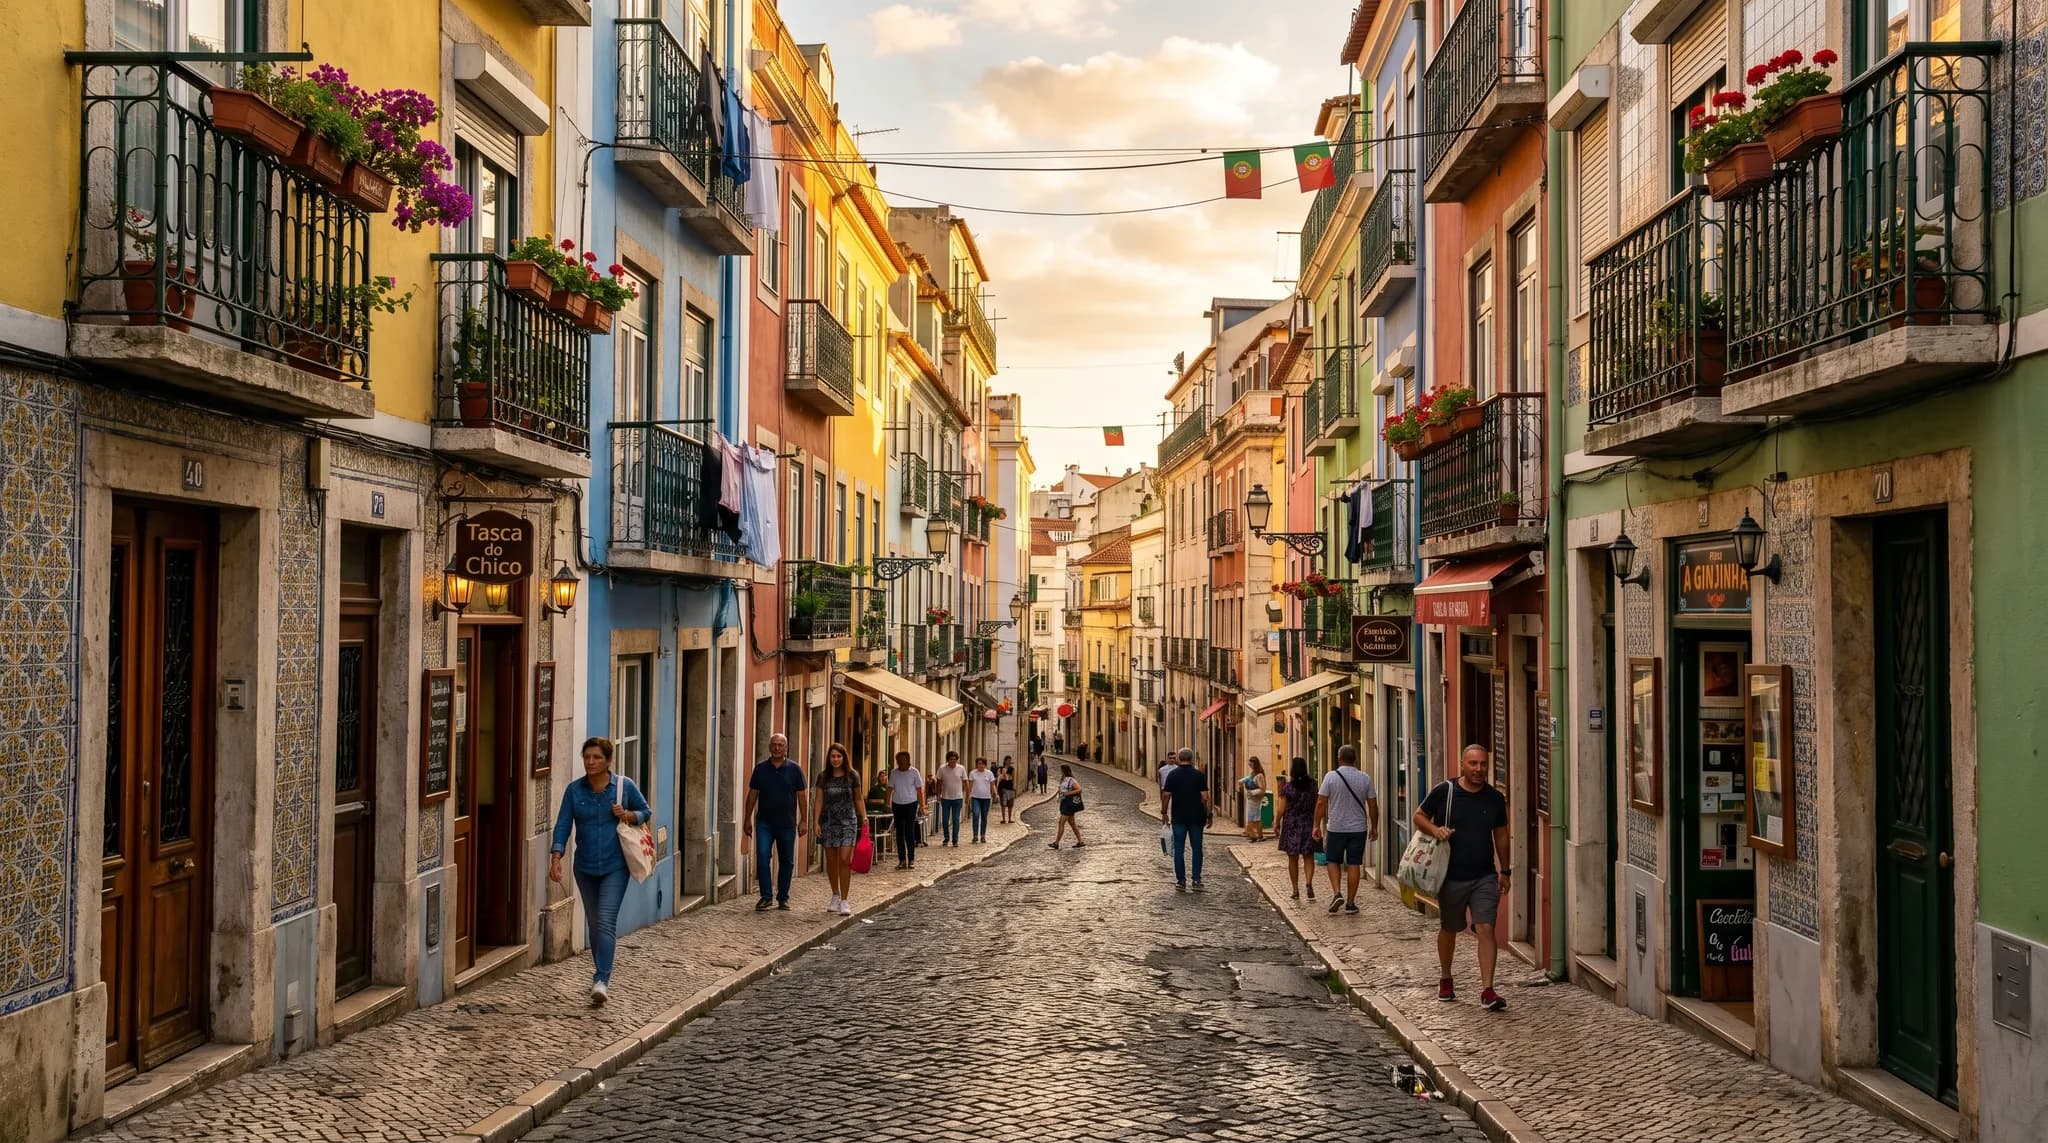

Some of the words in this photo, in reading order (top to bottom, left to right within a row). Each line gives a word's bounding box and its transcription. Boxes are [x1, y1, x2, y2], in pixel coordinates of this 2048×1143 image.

[186, 461, 202, 487] 40
[1875, 471, 1889, 500] 70
[466, 523, 522, 541] Tasca
[484, 543, 503, 556] do
[466, 556, 522, 575] Chico
[1684, 565, 1692, 592] A
[1694, 562, 1749, 591] GINJINHA
